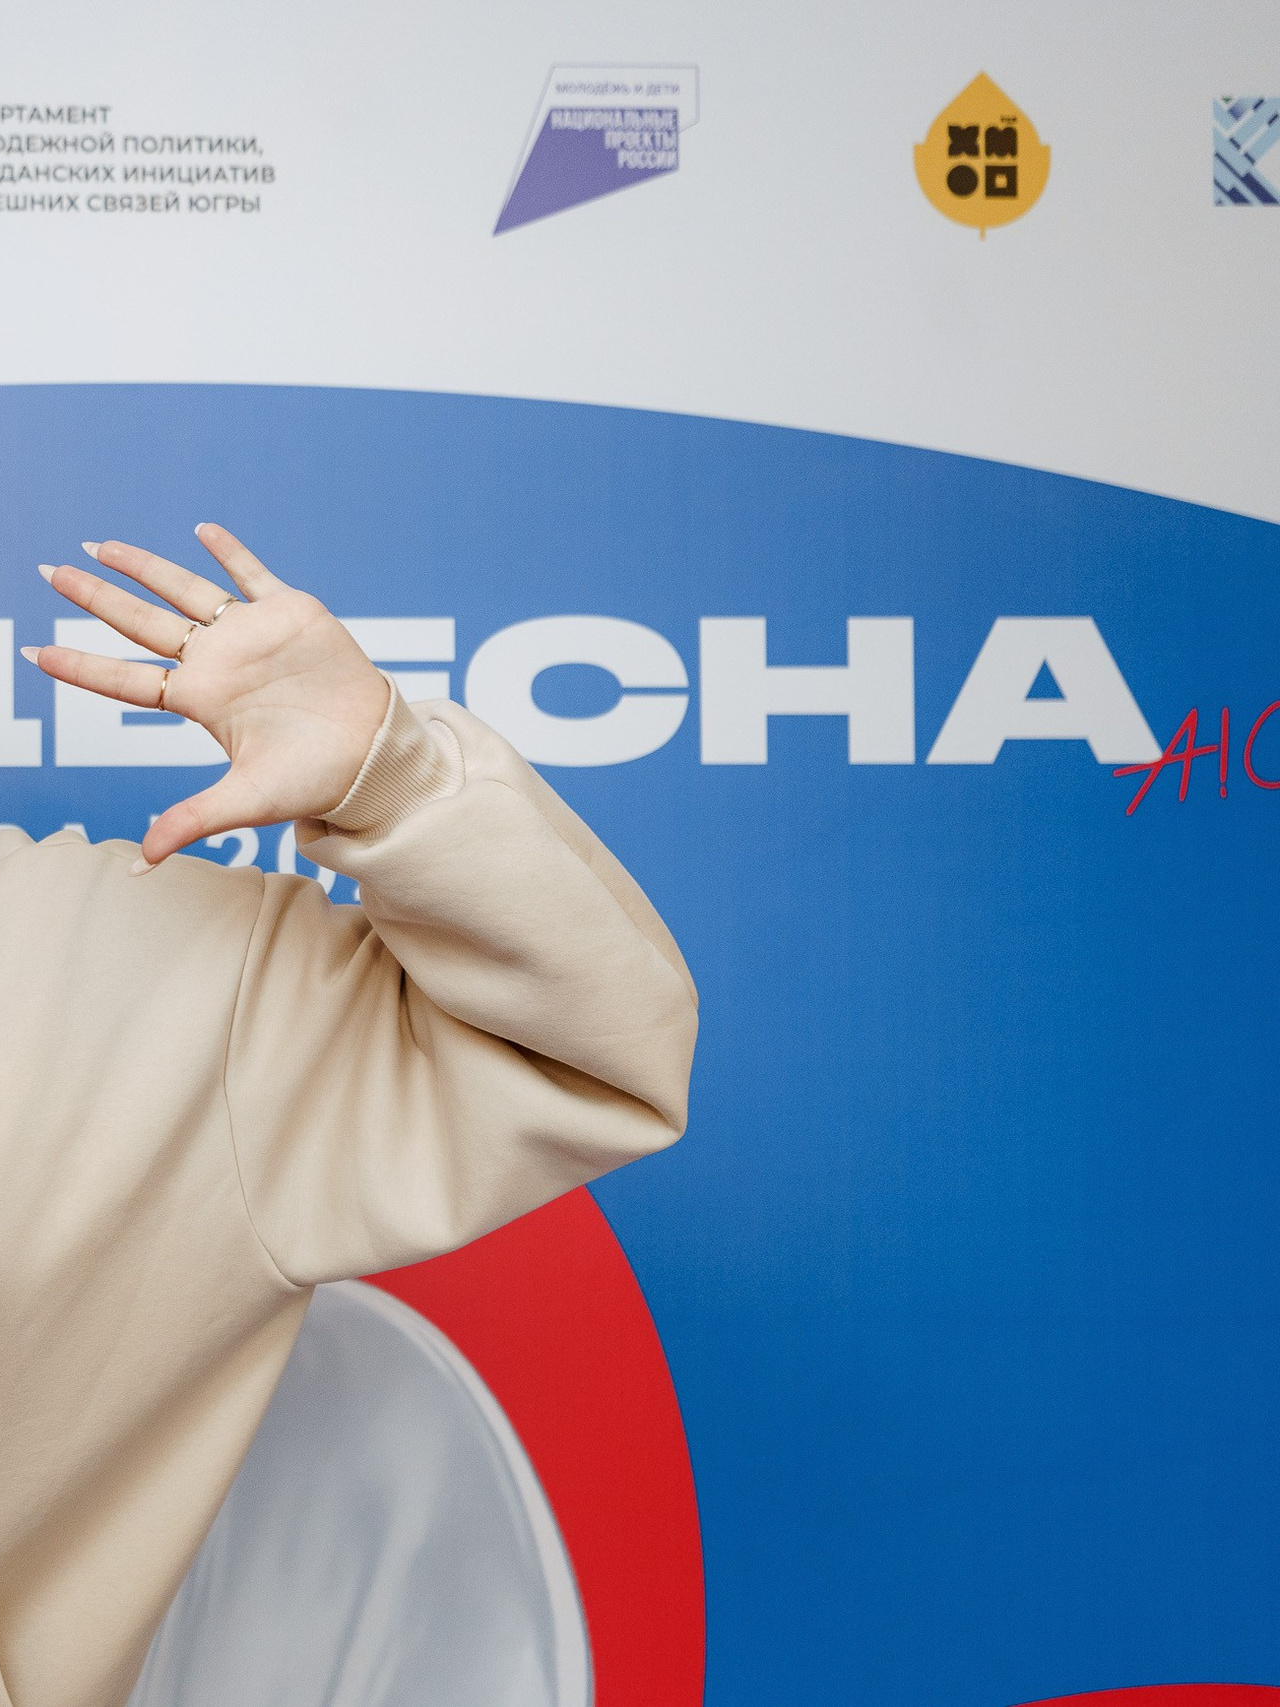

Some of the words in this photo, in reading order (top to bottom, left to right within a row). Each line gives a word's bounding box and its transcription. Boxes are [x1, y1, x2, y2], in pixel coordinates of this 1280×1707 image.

[123, 134, 263, 156] ПОЛИТИКИ,
[123, 165, 275, 186] ИНИЦИАТИВ
[87, 190, 180, 213] СВЯЗЕЙ
[188, 194, 261, 213] ЮГРЫ
